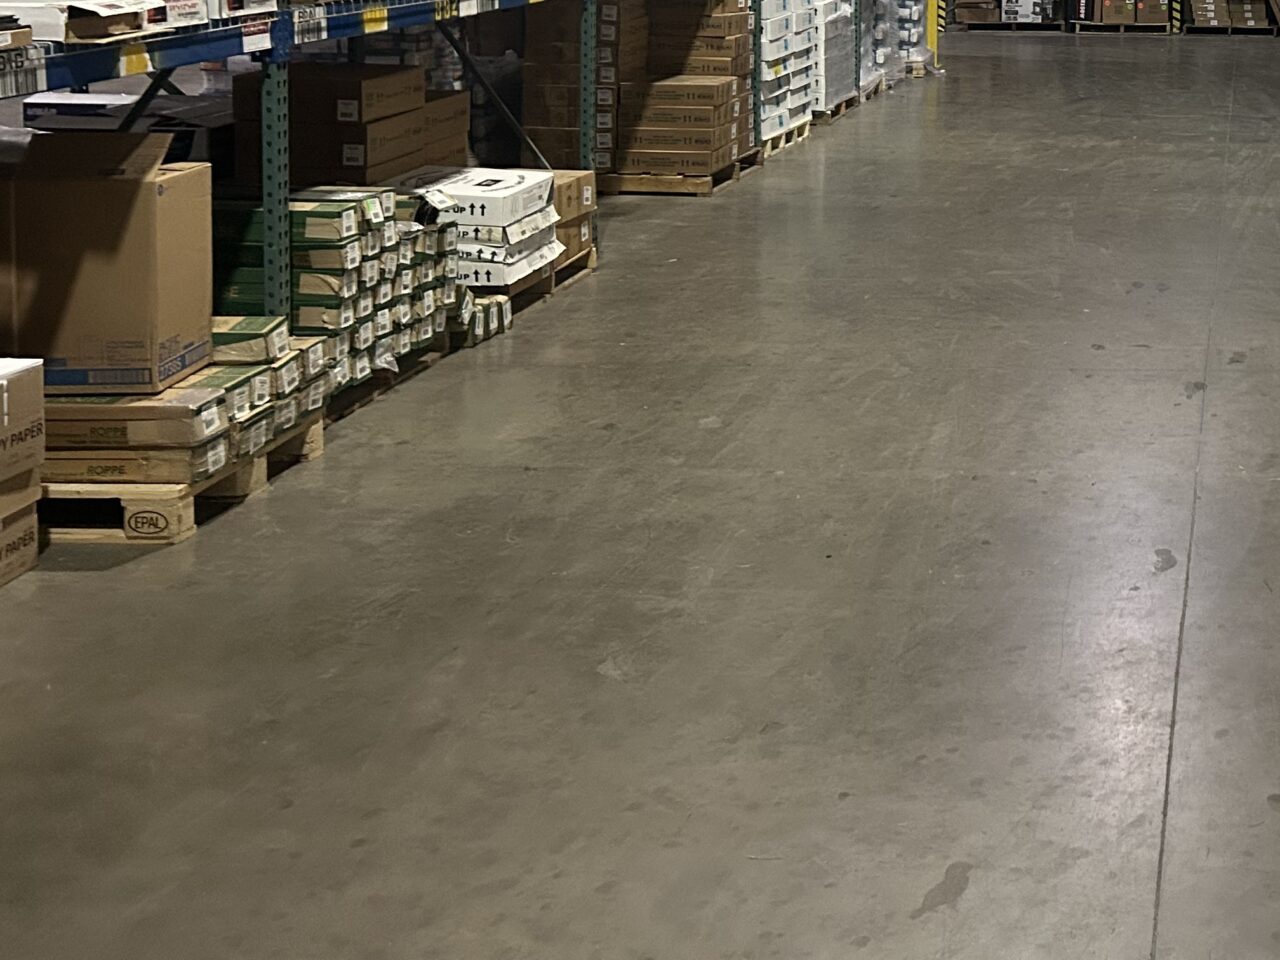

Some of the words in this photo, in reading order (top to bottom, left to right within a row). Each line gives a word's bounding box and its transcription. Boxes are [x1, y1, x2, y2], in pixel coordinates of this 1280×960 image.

[11, 422, 44, 447] PAPER
[87, 465, 126, 476] ROPPE
[134, 515, 162, 529] EPAL
[5, 530, 36, 558] PAPER
